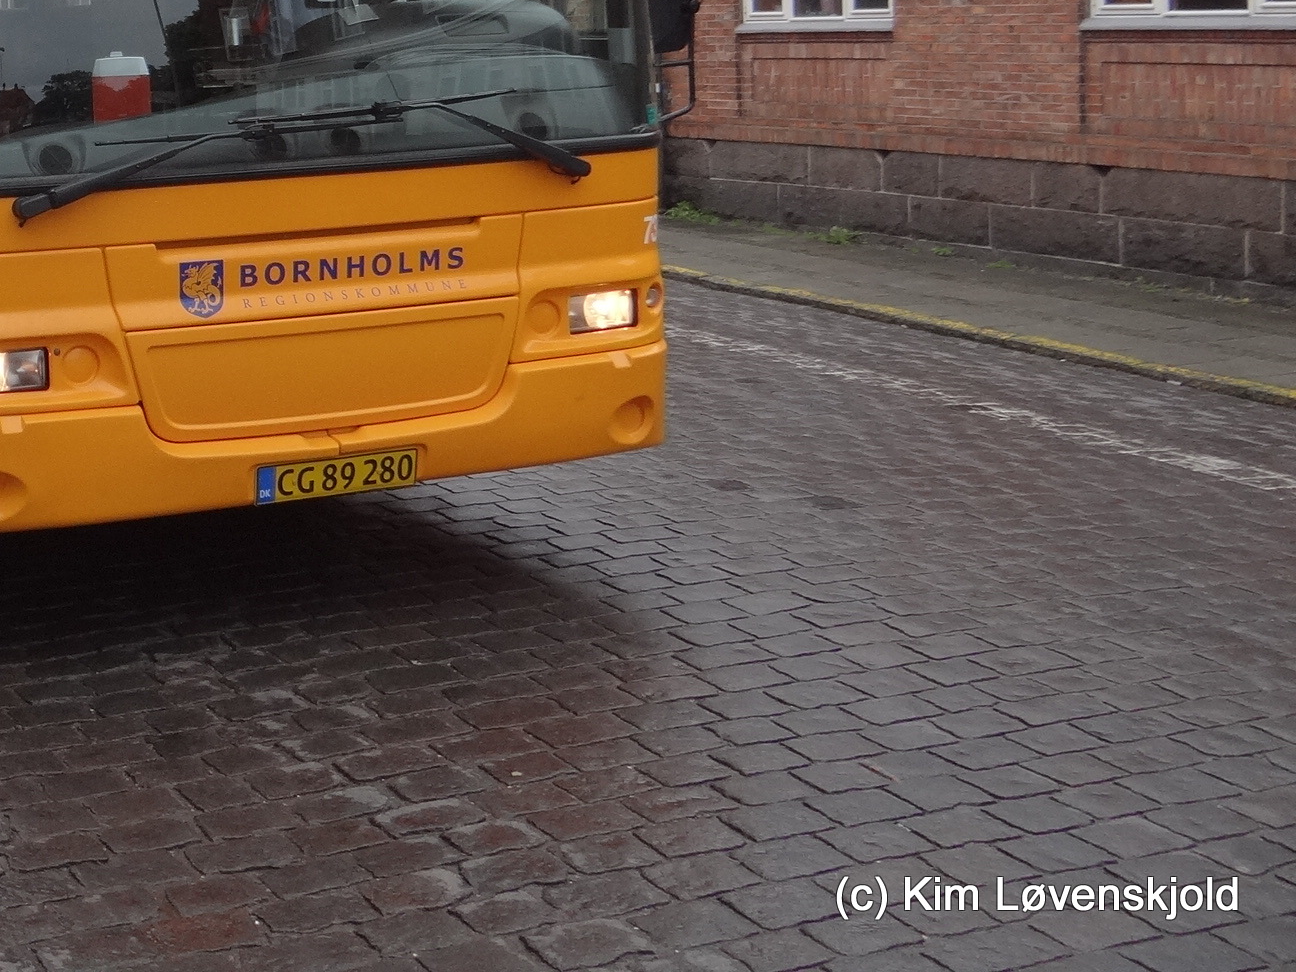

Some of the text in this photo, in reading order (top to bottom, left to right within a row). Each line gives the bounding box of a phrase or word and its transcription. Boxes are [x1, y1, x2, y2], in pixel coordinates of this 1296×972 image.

[239, 246, 465, 289] BORNHOLMS
[242, 278, 468, 309] REGIONSKOMMUNE
[259, 453, 413, 499] DK CG 89 280
